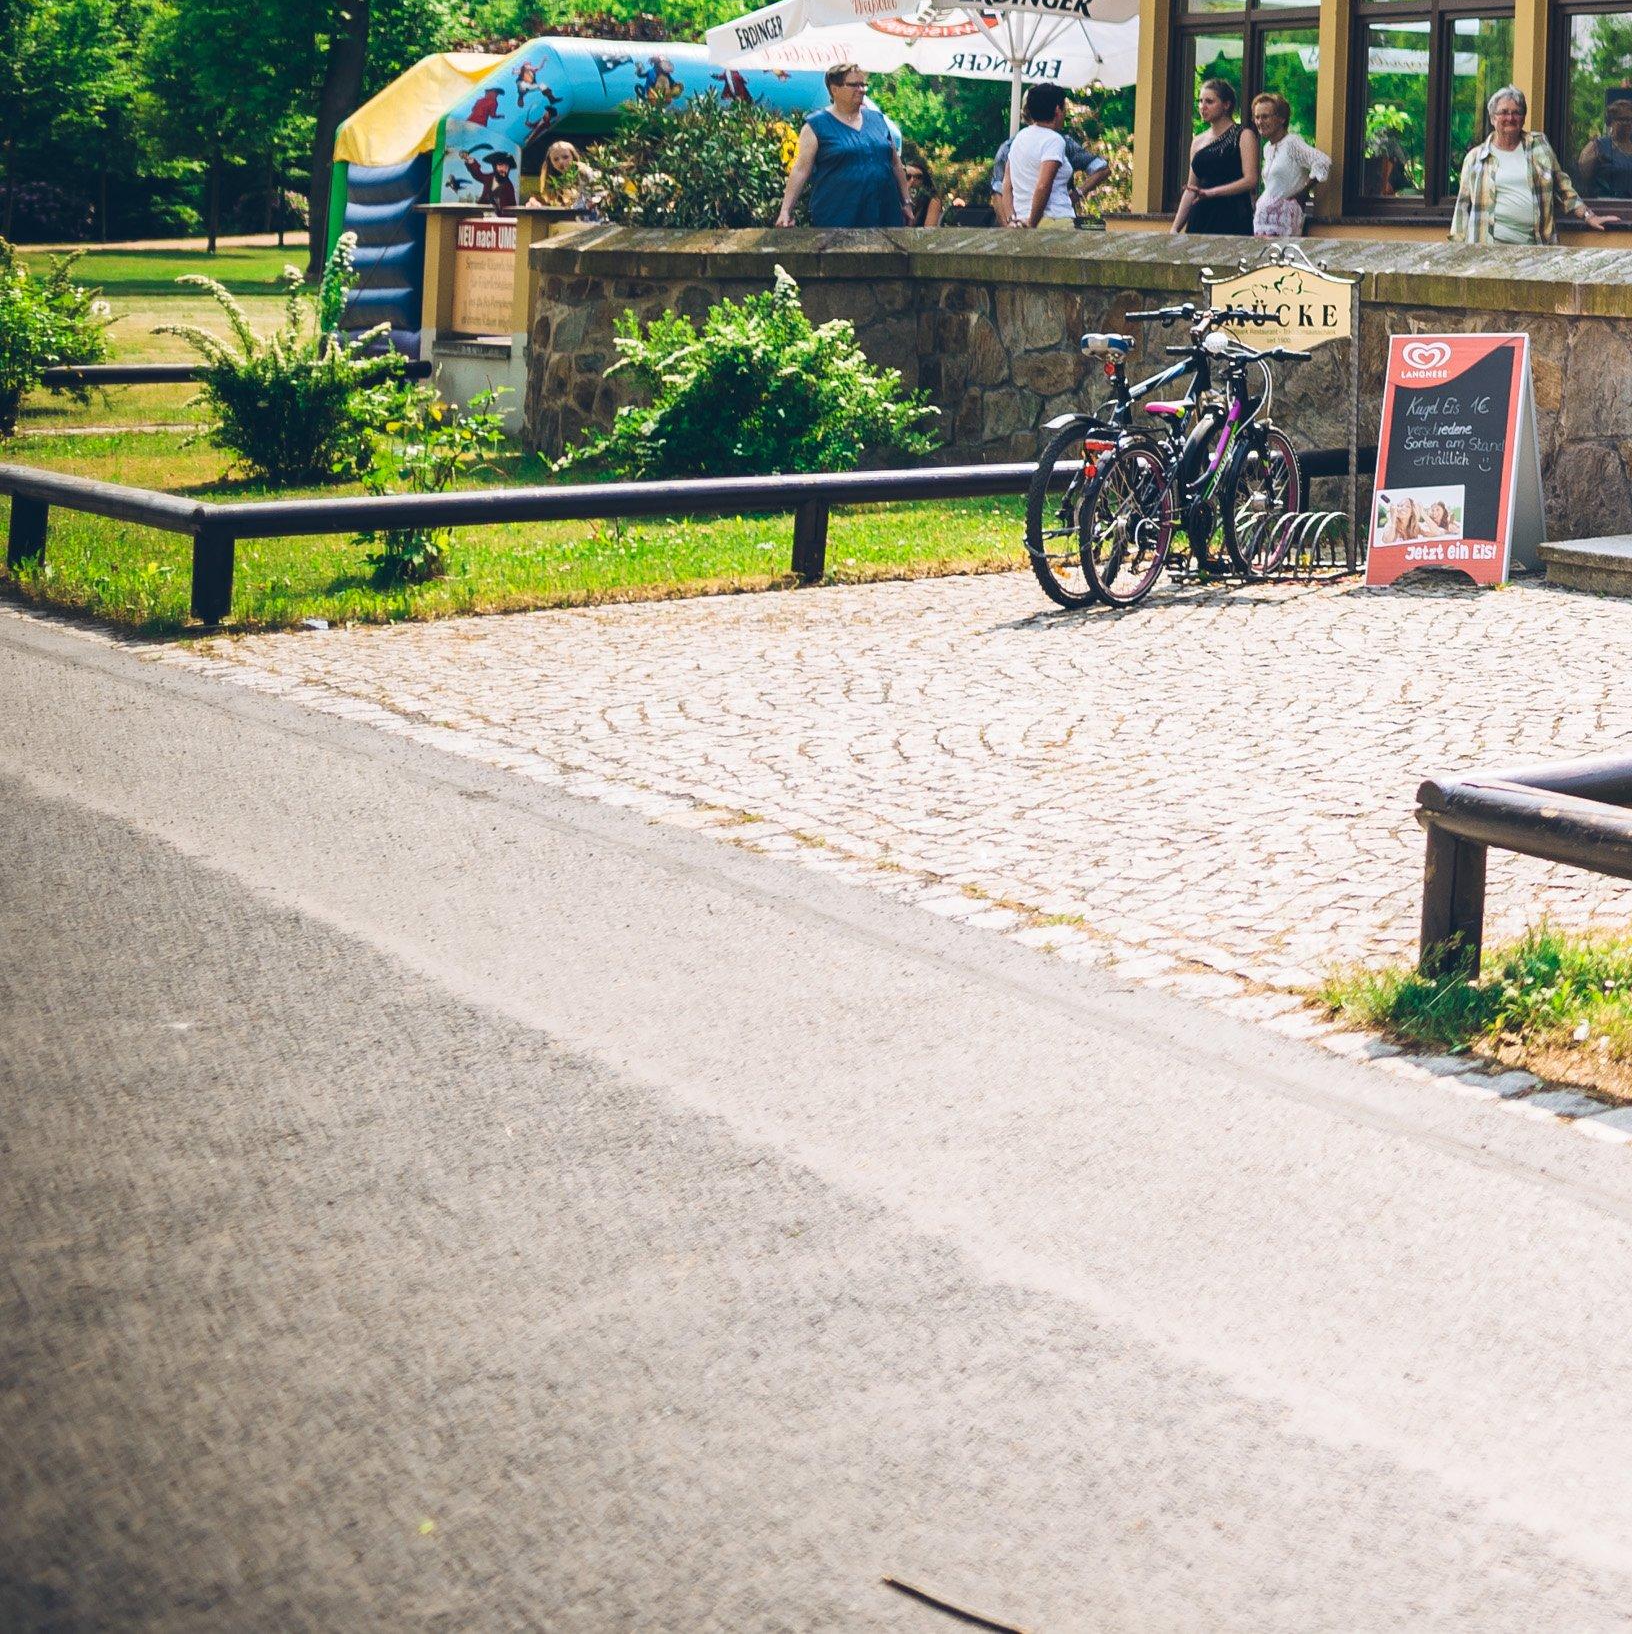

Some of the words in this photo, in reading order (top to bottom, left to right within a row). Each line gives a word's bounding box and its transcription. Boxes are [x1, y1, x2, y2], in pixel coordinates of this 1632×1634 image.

[735, 15, 784, 51] ERDINGER
[458, 224, 475, 247] NEU
[476, 225, 496, 249] nach
[1225, 299, 1338, 327] MÜCKE
[1401, 370, 1448, 379] LANGNESE
[1406, 396, 1438, 421] Kugel
[1442, 397, 1460, 415] Eis
[1404, 436, 1439, 450] Sorten
[1445, 439, 1465, 450] am
[1404, 544, 1444, 561] Jetzt
[1447, 541, 1469, 560] ein
